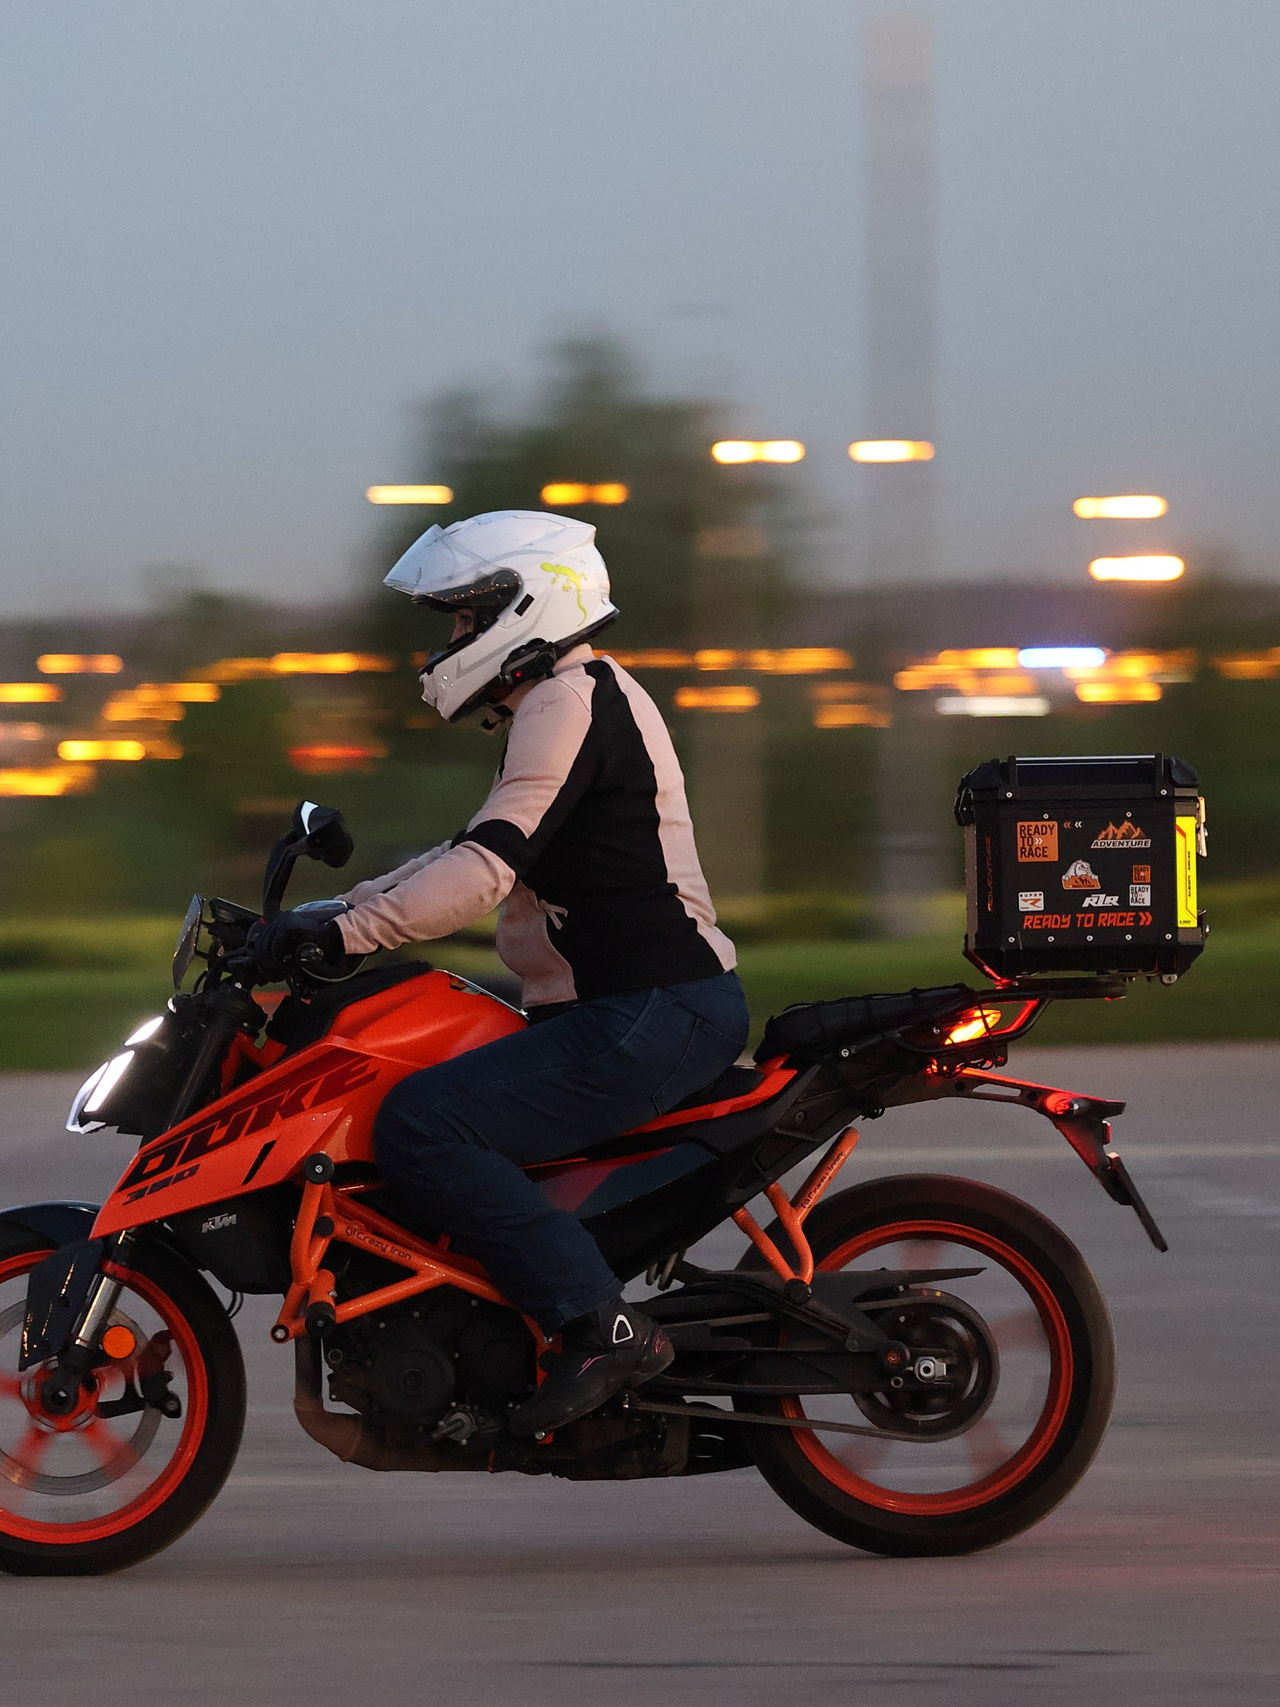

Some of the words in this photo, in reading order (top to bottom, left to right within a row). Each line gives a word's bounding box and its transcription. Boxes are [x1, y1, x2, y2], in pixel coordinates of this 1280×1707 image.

[1019, 824, 1055, 838] READY
[1020, 836, 1034, 847] TO
[1091, 839, 1151, 848] ADVENTURE
[1020, 846, 1049, 858] RACE
[1023, 914, 1071, 929] READY
[1075, 913, 1095, 928] TO
[1097, 911, 1136, 927] RACE
[117, 1055, 381, 1193] DUKE
[201, 1213, 237, 1234] KTM
